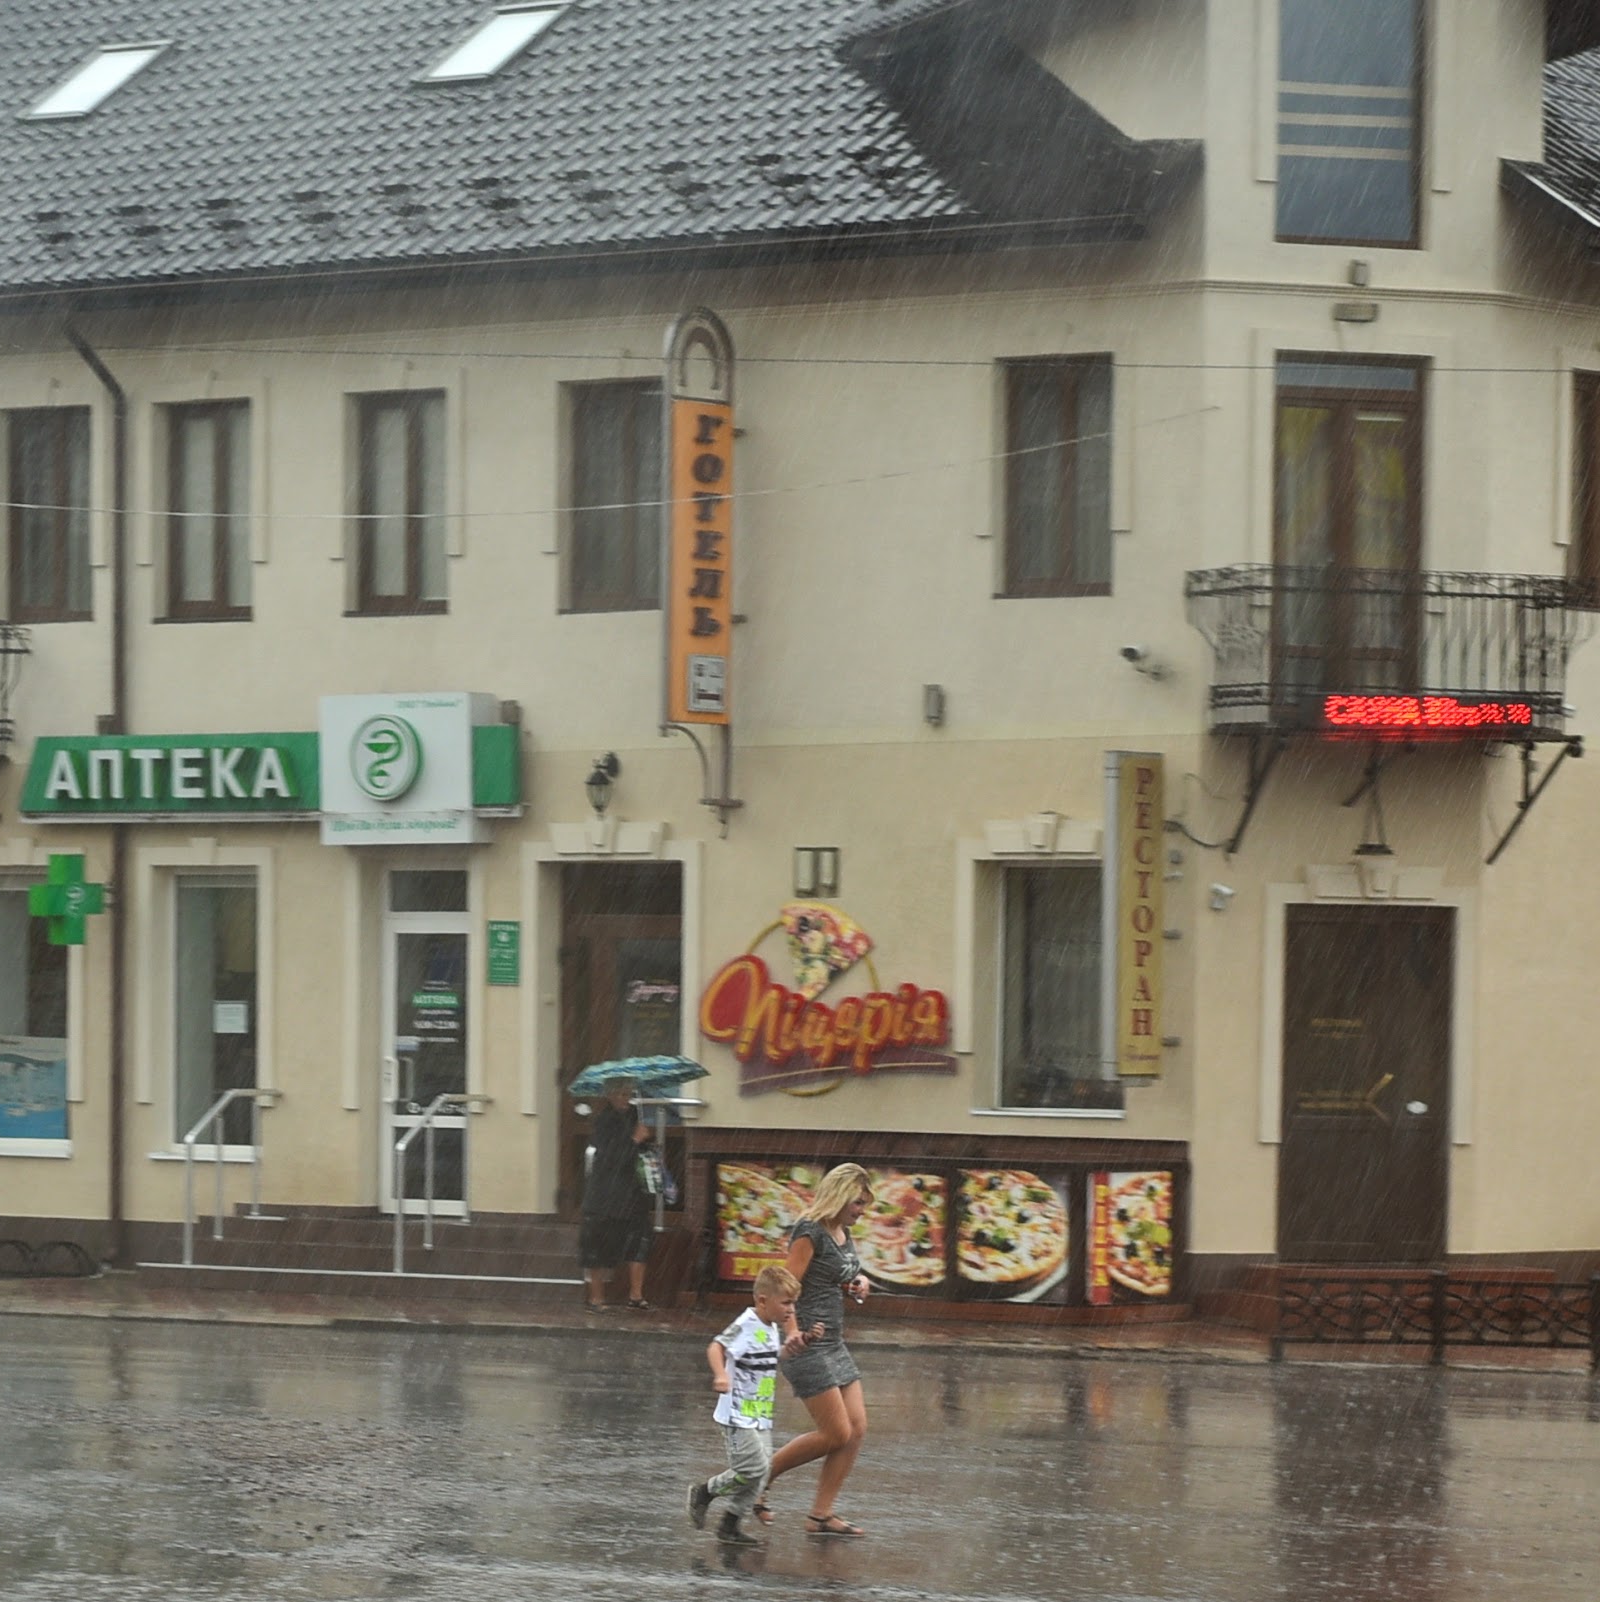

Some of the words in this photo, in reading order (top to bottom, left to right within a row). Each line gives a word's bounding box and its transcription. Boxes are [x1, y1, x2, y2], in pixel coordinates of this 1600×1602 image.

[690, 413, 725, 637] ГОТЕЛЬ
[45, 748, 292, 800] АПТЕКА
[1131, 766, 1155, 1036] РЕСТОРАН
